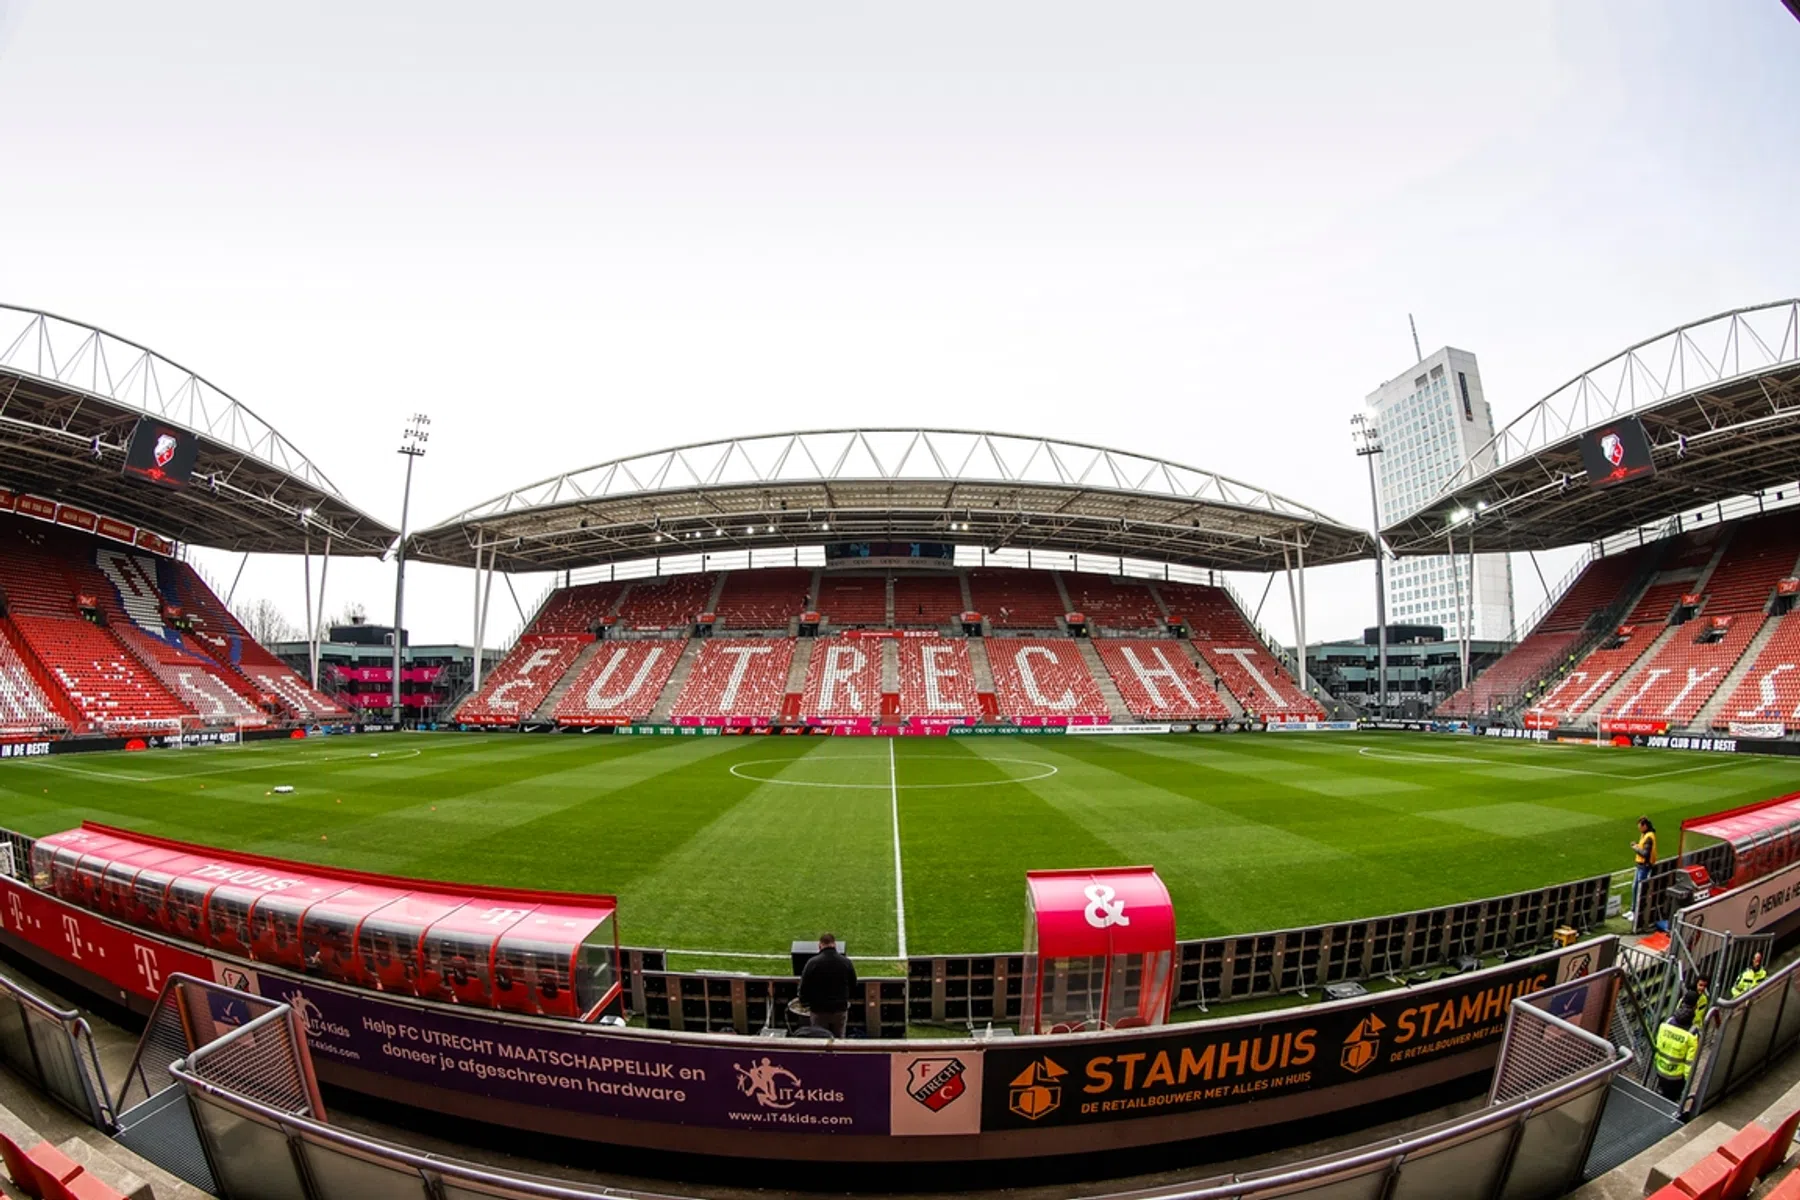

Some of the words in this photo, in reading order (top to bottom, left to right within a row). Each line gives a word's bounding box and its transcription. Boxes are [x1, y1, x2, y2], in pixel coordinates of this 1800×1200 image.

[2, 744, 12, 757] IN
[13, 744, 24, 756] DE
[26, 742, 50, 755] BESTE
[1647, 736, 1670, 747] JOUW
[1670, 737, 1690, 748] CLUB
[1690, 738, 1700, 749] IN
[1702, 739, 1712, 750] DE
[1713, 740, 1737, 751] BESTE
[189, 863, 306, 891] THUIS
[1084, 884, 1130, 928] &
[363, 1016, 397, 1038] Help
[400, 1024, 419, 1041] FC
[422, 1027, 494, 1056] UTRECHT
[498, 1043, 675, 1080] MAATSCHAPPELIJK
[679, 1066, 706, 1082] en
[1083, 1028, 1318, 1094] STAMHUIS
[1390, 1051, 1402, 1063] DE
[1404, 1034, 1471, 1061] RETAILBOUWER
[1472, 1028, 1488, 1040] MET
[382, 1041, 438, 1066] doneer
[439, 1052, 455, 1071] je
[458, 1056, 583, 1091] afgeschreven
[587, 1076, 686, 1102] hardware
[914, 1061, 963, 1102] UTRECHT
[921, 1064, 931, 1078] F
[940, 1086, 953, 1100] C
[1081, 1101, 1099, 1114] DE
[1102, 1090, 1202, 1112] RETAILBOUWER
[1204, 1086, 1229, 1100] MET
[1232, 1080, 1270, 1096] ALLES
[1271, 1076, 1282, 1088] IN
[1285, 1071, 1311, 1084] HUIS
[728, 1110, 854, 1125] www.IT4kids.com
